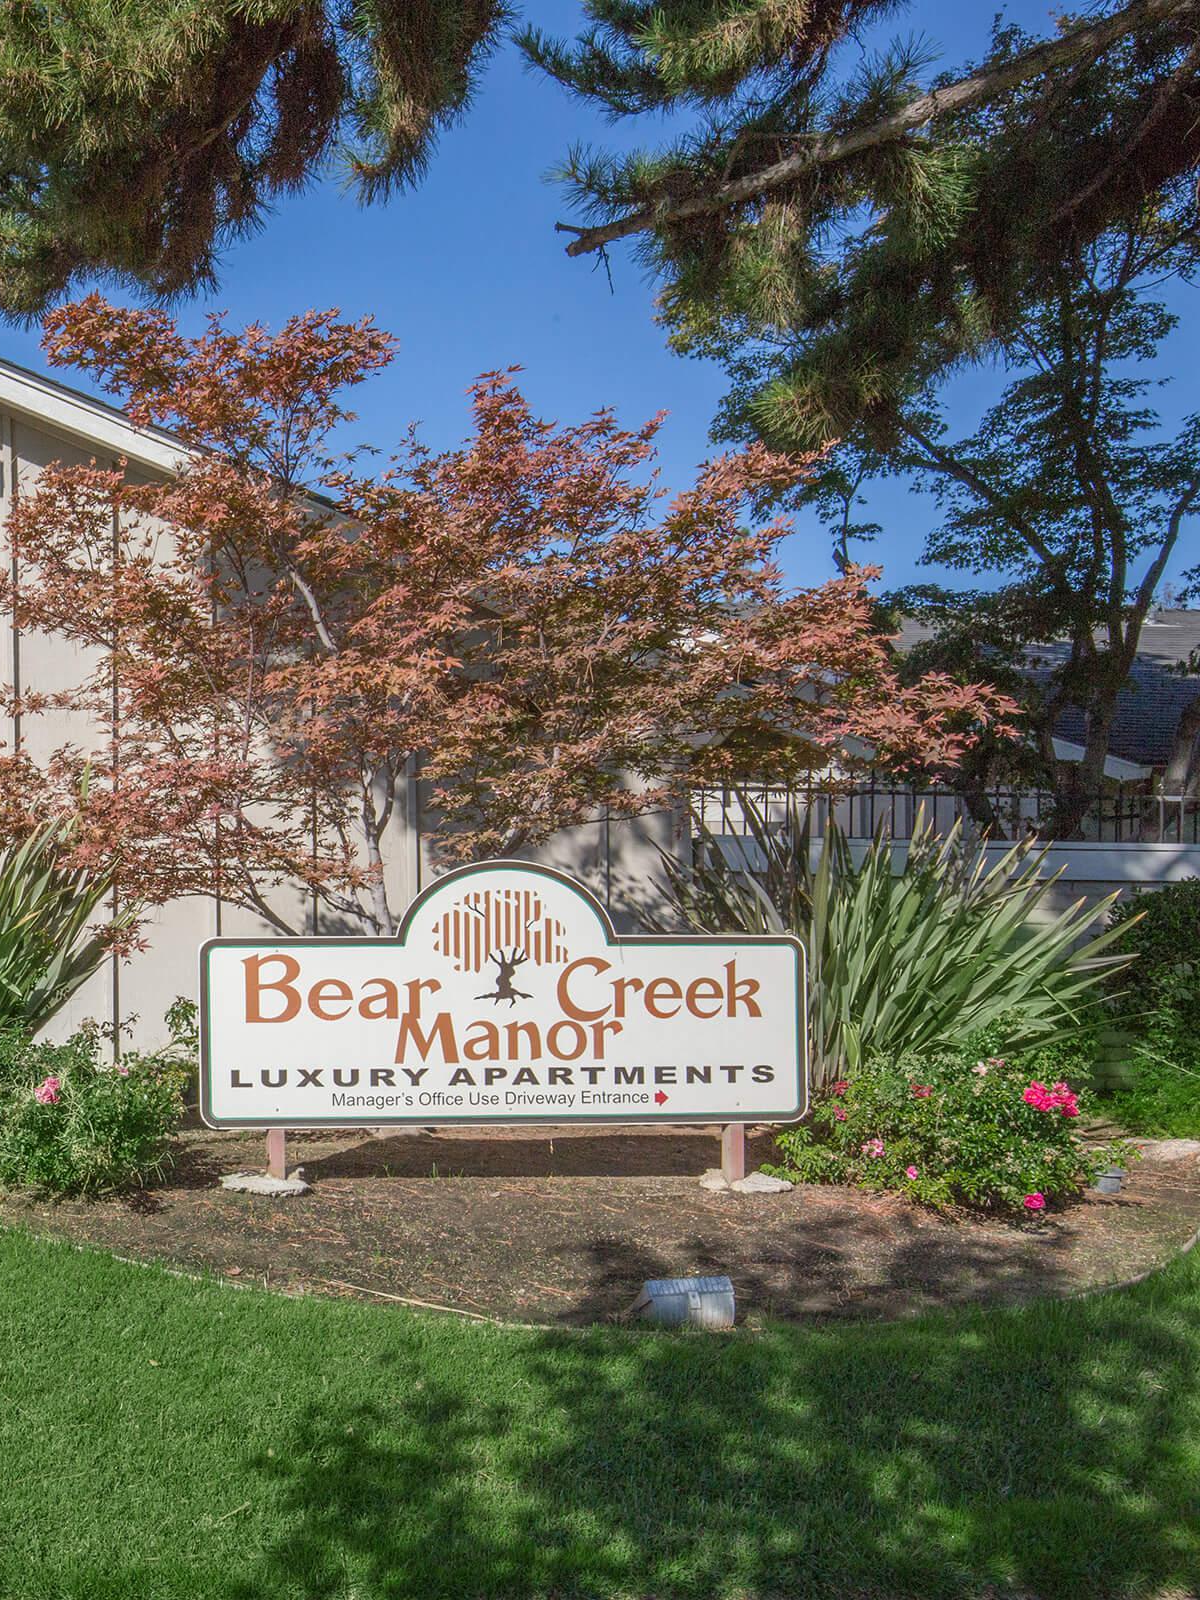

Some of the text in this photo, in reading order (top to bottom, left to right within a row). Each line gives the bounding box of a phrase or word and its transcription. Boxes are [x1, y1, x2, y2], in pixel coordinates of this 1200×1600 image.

[240, 953, 763, 1024] Bear Creek
[394, 1012, 623, 1064] Manor
[230, 1065, 776, 1089] LUXURY APARTMENTS
[331, 1090, 650, 1109] Manager's Office Use Driveway Entrance
